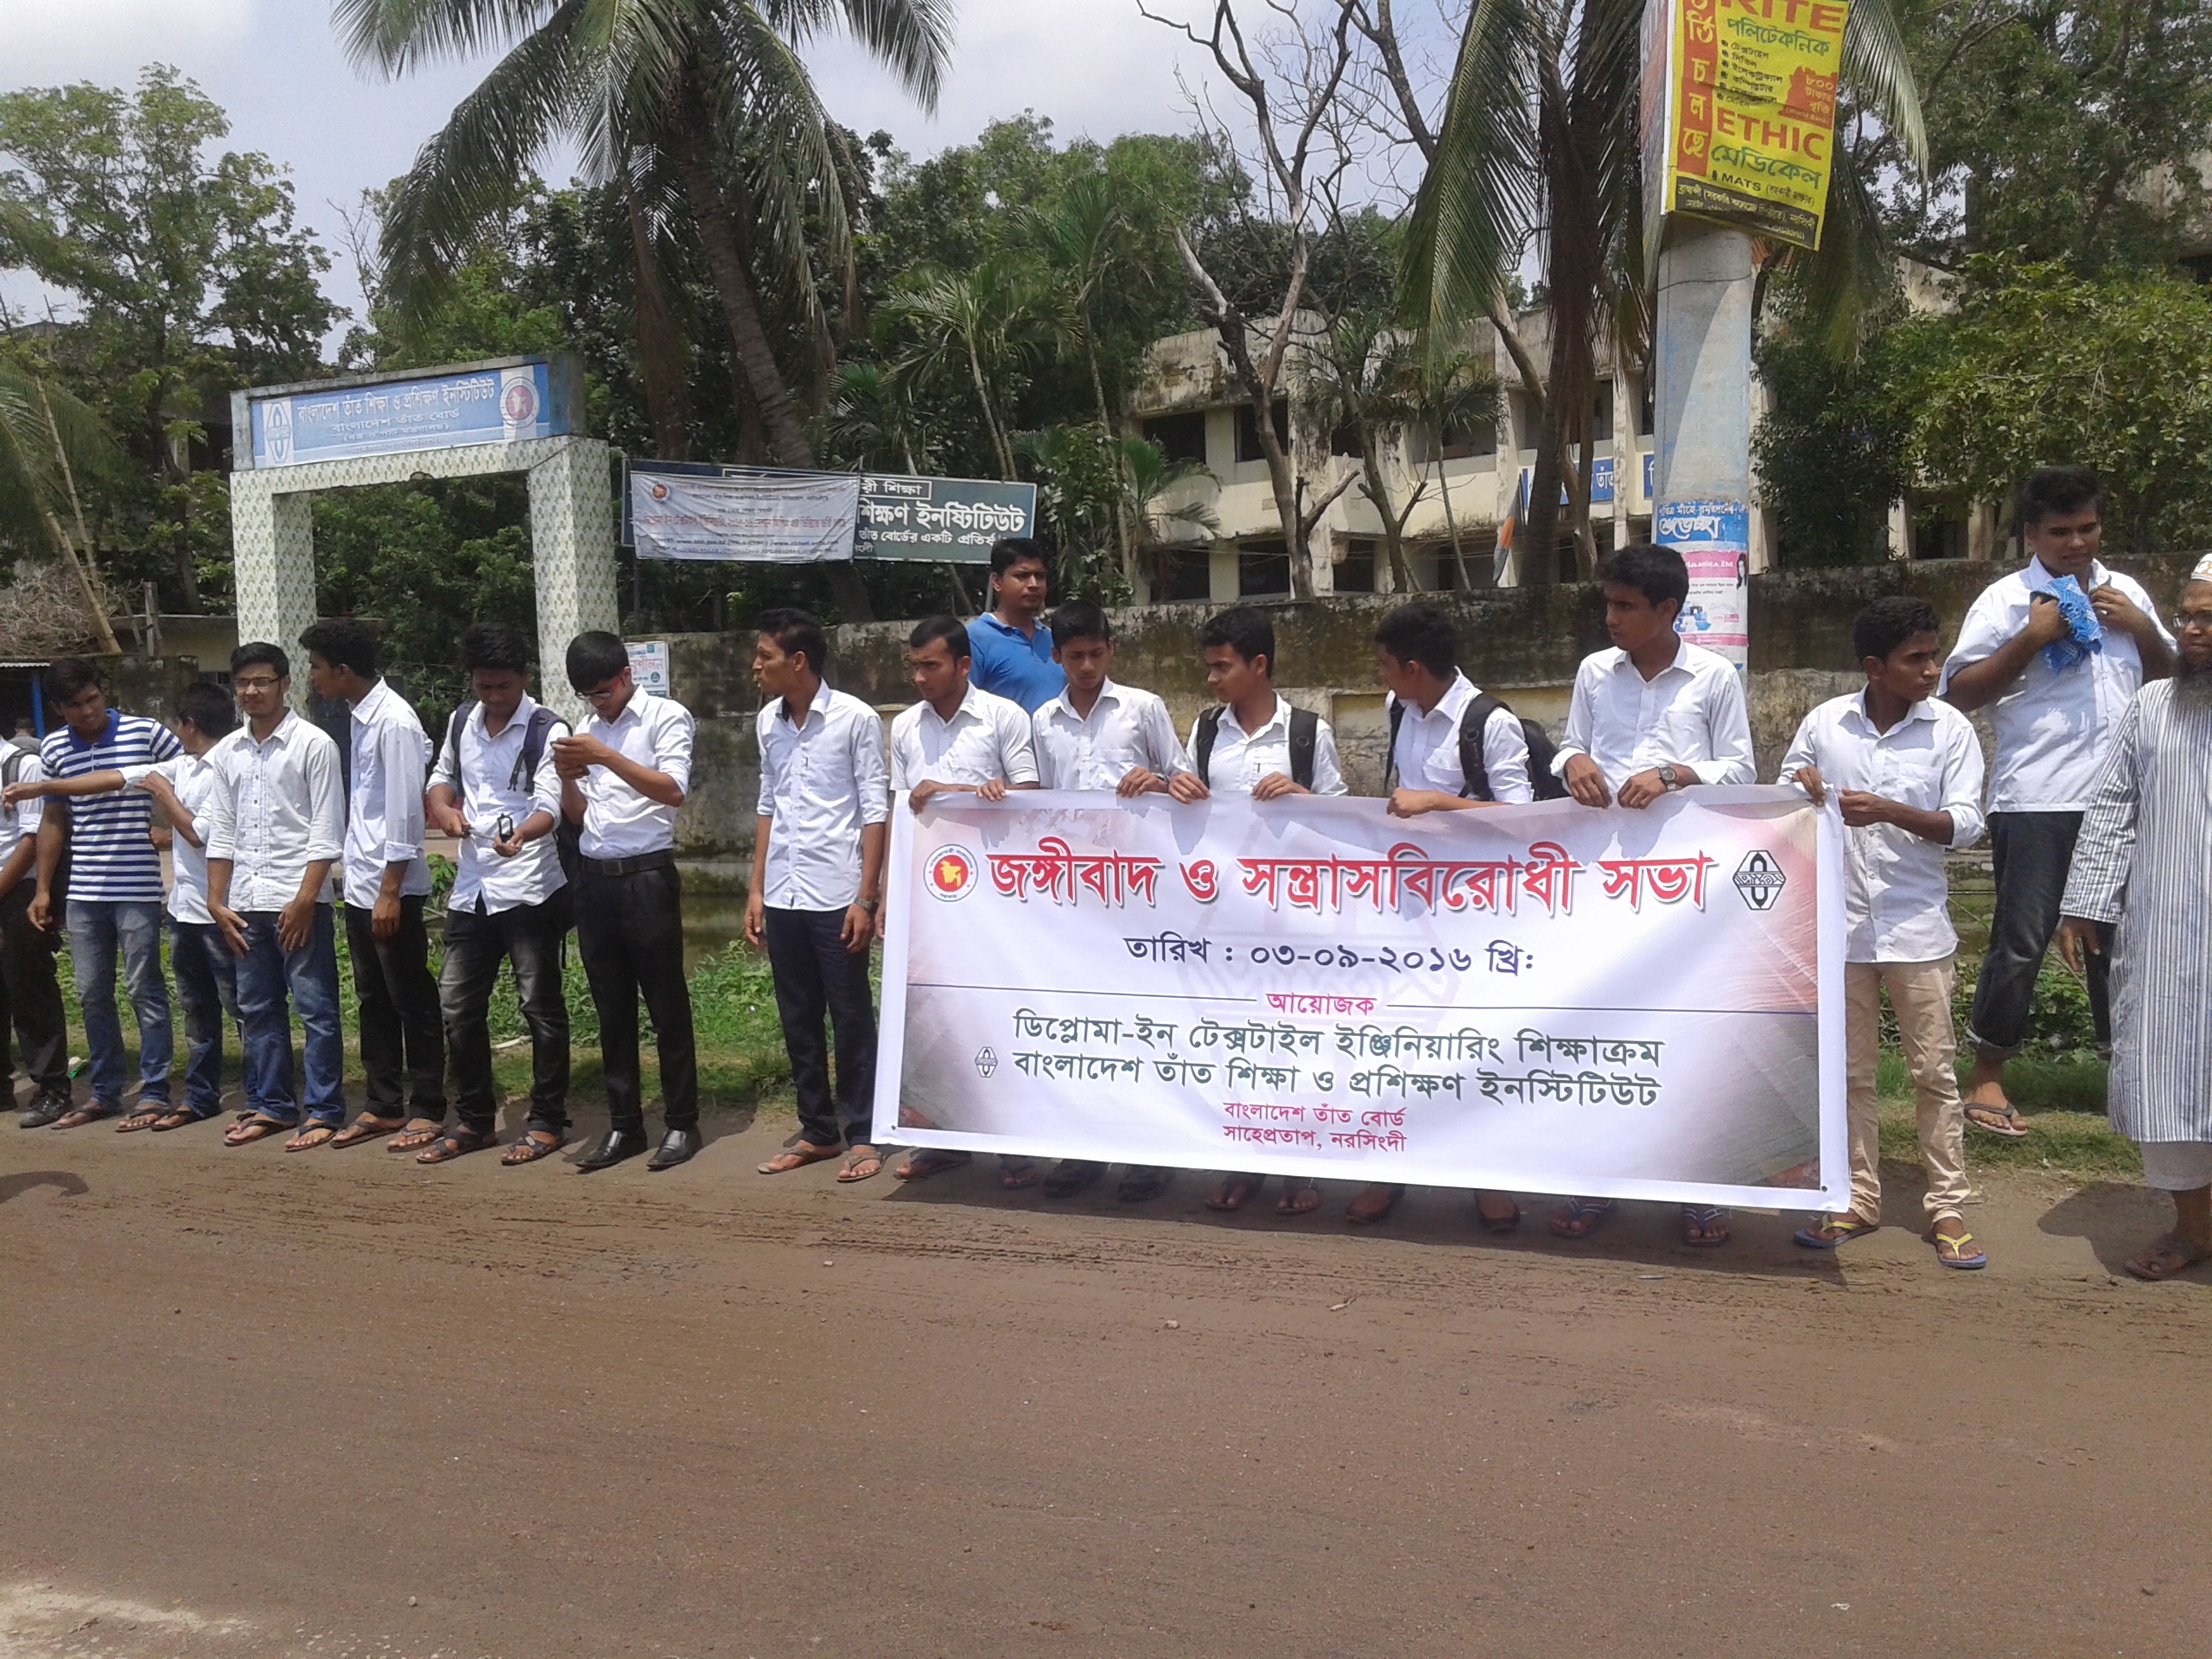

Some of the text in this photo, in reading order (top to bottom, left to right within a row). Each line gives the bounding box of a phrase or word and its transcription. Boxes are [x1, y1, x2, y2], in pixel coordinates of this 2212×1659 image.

[1727, 16, 1831, 56] পলিটেকনিক
[1805, 74, 1834, 91] ৮০০
[1716, 106, 1825, 161] ETHIC
[1711, 144, 1822, 190] মেডিকেল
[1721, 173, 1762, 192] MATS
[297, 401, 340, 424] বাংলাদেশ
[342, 394, 363, 416] তাঁত
[393, 399, 400, 410] ও
[404, 385, 439, 411] প্রশিক্ষণ
[861, 479, 878, 494] রী
[883, 480, 923, 495] শিক্ষা
[880, 527, 918, 543] বোর্ডের
[920, 529, 953, 543] একটি
[986, 836, 1166, 908] জঙ্গীবাদ
[1180, 857, 1220, 903] ও
[1236, 842, 1584, 916] সন্ত্রাসবিরোধী
[1597, 849, 1719, 913] সভা
[1123, 931, 1212, 964] তারিখ
[1250, 944, 1472, 973] ০৩-০৯-২০১৬
[1266, 992, 1378, 1017] আয়োজক
[1013, 1007, 1666, 1068] ডিপ্লোমা-ইন টেক্সটাইল ইঞ্জিনিয়ারিং শিক্ষাক্রম
[1012, 1051, 1662, 1106] বাংলাদেশ তাঁত শিক্ষা ও প্রশিক্ষণ ইনস্টিটিউট
[1223, 1102, 1407, 1126] বাংলাদেশ তাঁত বোর্ড
[1223, 1125, 1408, 1152] সাহেপ্রতাপ, নরসিংদী
